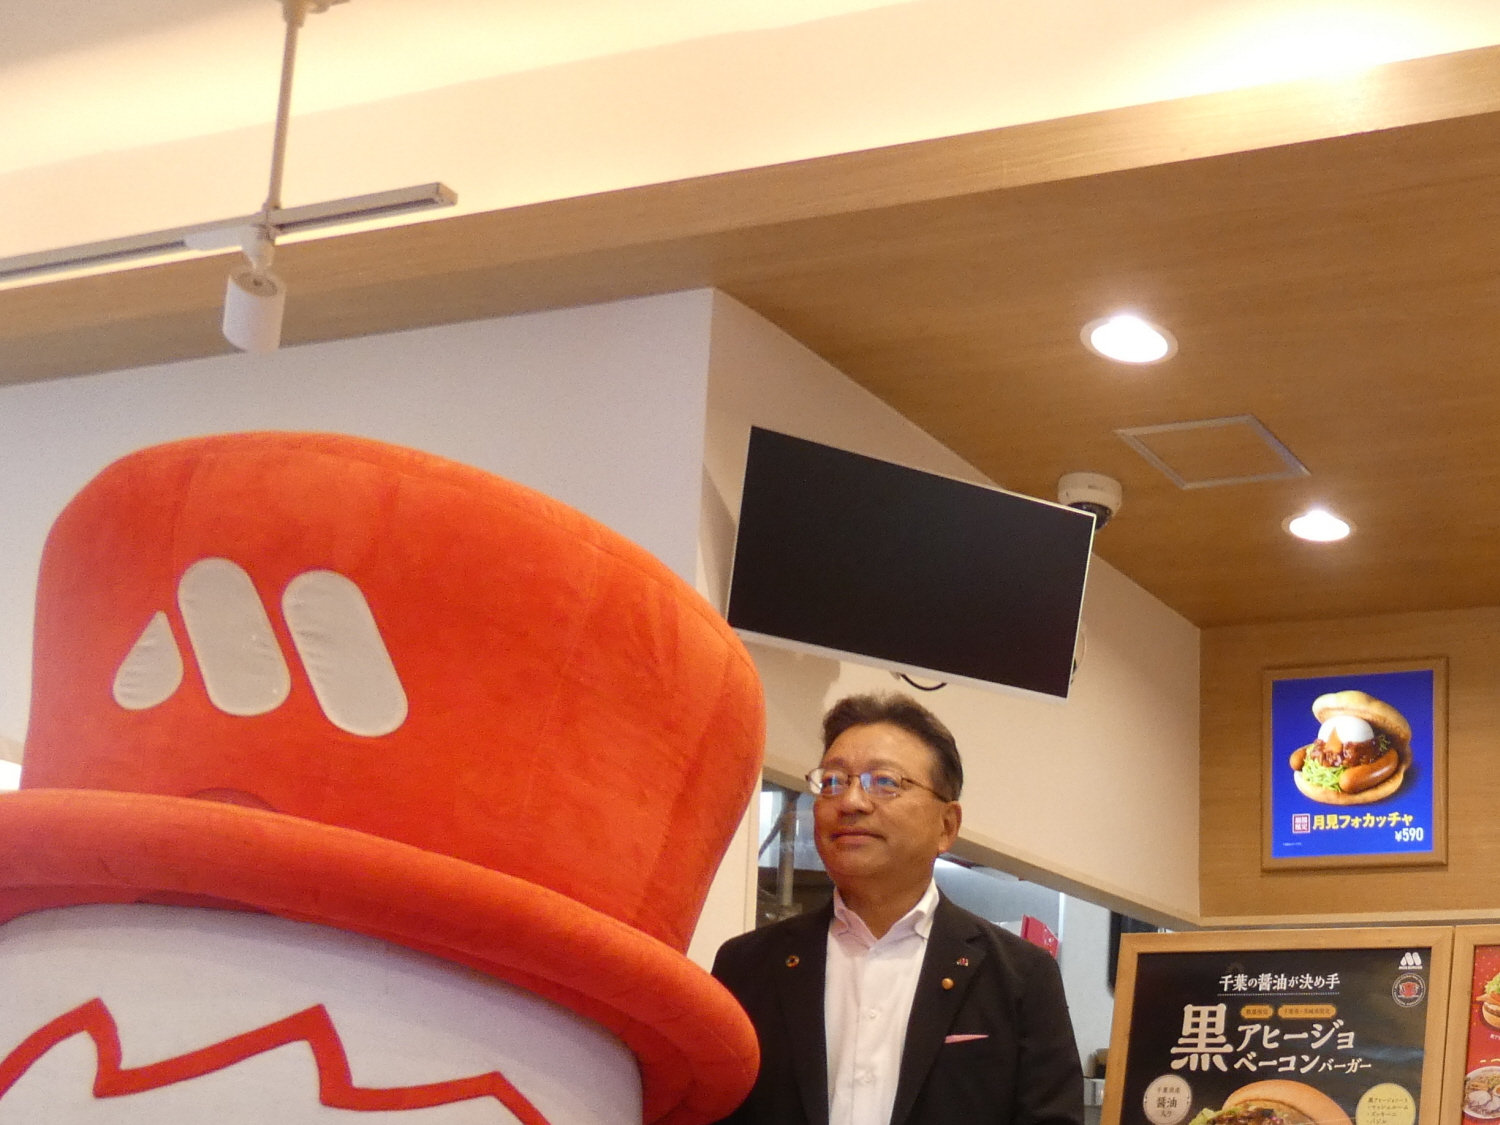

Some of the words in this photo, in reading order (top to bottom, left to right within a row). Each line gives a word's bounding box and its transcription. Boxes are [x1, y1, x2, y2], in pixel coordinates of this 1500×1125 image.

[1312, 812, 1414, 830] 月見フォカッチャ
[1395, 827, 1424, 842] ¥590
[1218, 972, 1341, 992] 千葉の醤油が決め手
[1170, 1003, 1234, 1072] 黒
[1236, 1019, 1355, 1052] アヒージョ
[1233, 1051, 1372, 1074] ベーコンバーガー
